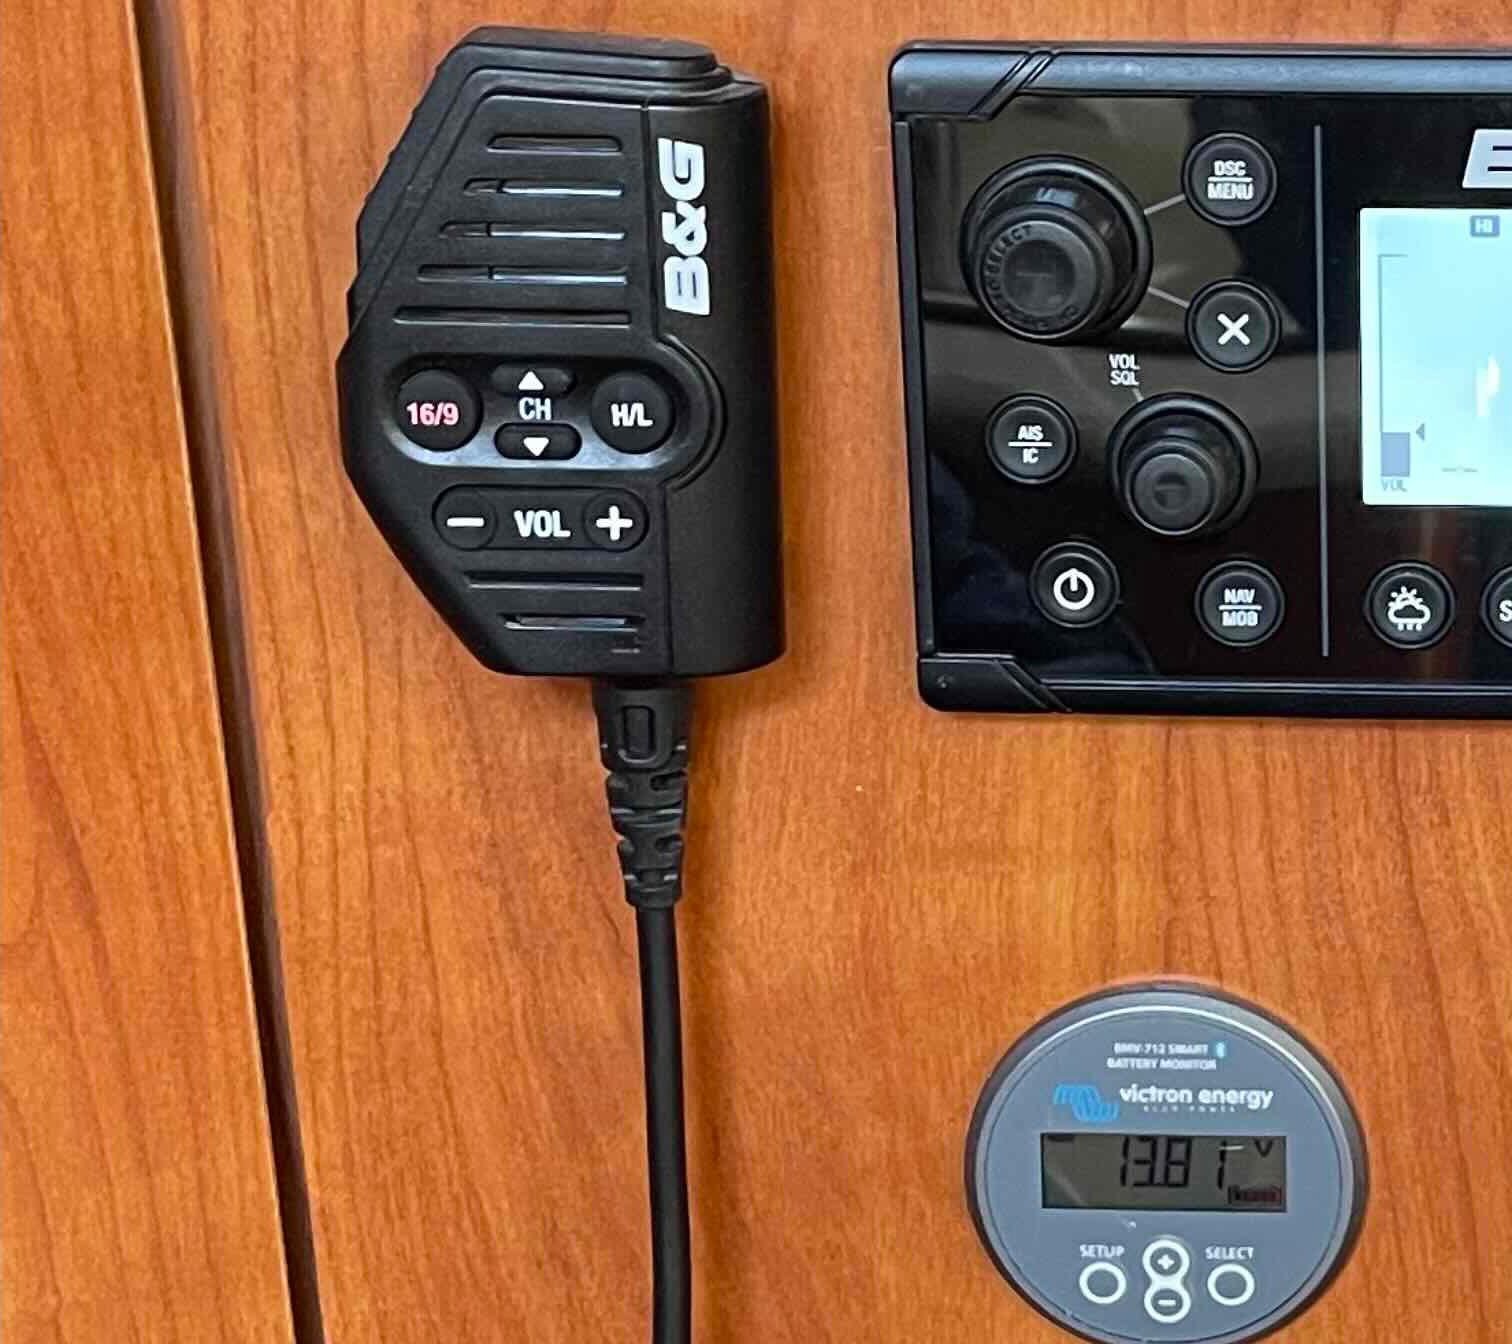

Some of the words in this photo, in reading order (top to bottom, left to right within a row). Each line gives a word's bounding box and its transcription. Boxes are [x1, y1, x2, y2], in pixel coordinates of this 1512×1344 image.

[1214, 160, 1246, 177] DSC
[1207, 183, 1253, 200] MENU
[658, 138, 710, 315] B&G
[1109, 354, 1139, 370] VOL
[1111, 370, 1138, 385] SQL
[407, 402, 459, 426] 16/9
[519, 397, 551, 421] CH
[611, 403, 652, 428] H/L
[1018, 425, 1043, 441] AIS
[1023, 448, 1039, 463] IC
[514, 510, 570, 538] VOL
[1224, 588, 1255, 603] NAV
[1120, 1084, 1192, 1103] victron
[1198, 1088, 1273, 1110] energy
[1080, 1245, 1124, 1257] SETUP
[1205, 1246, 1254, 1259] SELECT
